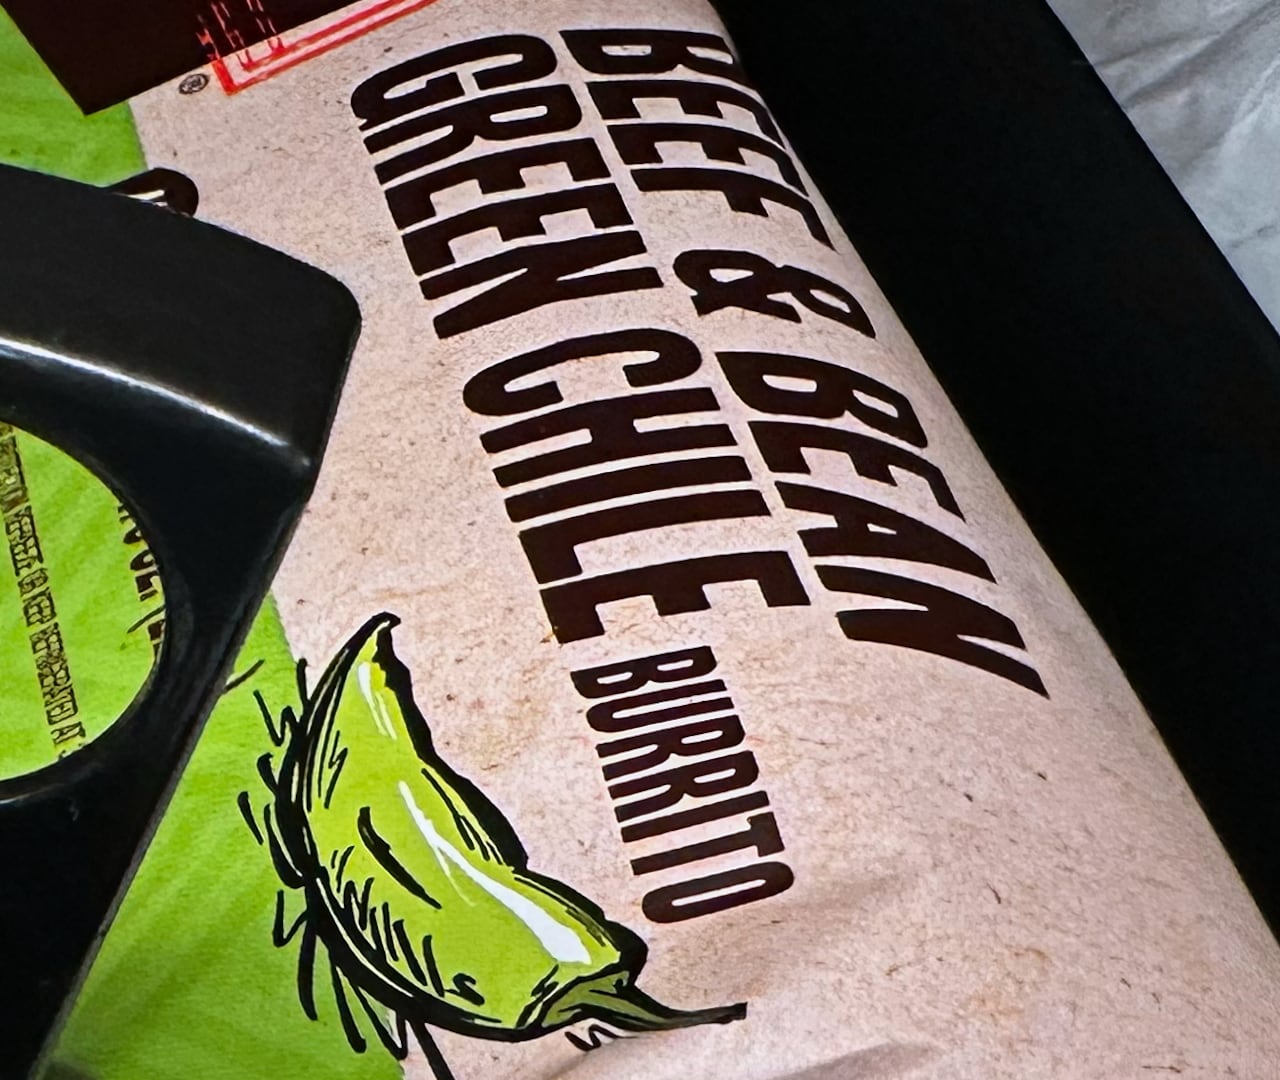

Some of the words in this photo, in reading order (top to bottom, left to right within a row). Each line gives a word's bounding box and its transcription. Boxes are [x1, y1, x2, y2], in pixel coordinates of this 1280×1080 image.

[350, 32, 664, 340] GREEN
[559, 28, 840, 254] BEEF
[672, 248, 877, 339] &
[462, 327, 811, 644] CHILE
[715, 350, 1050, 700] BEAN
[570, 645, 794, 925] BURRITO
